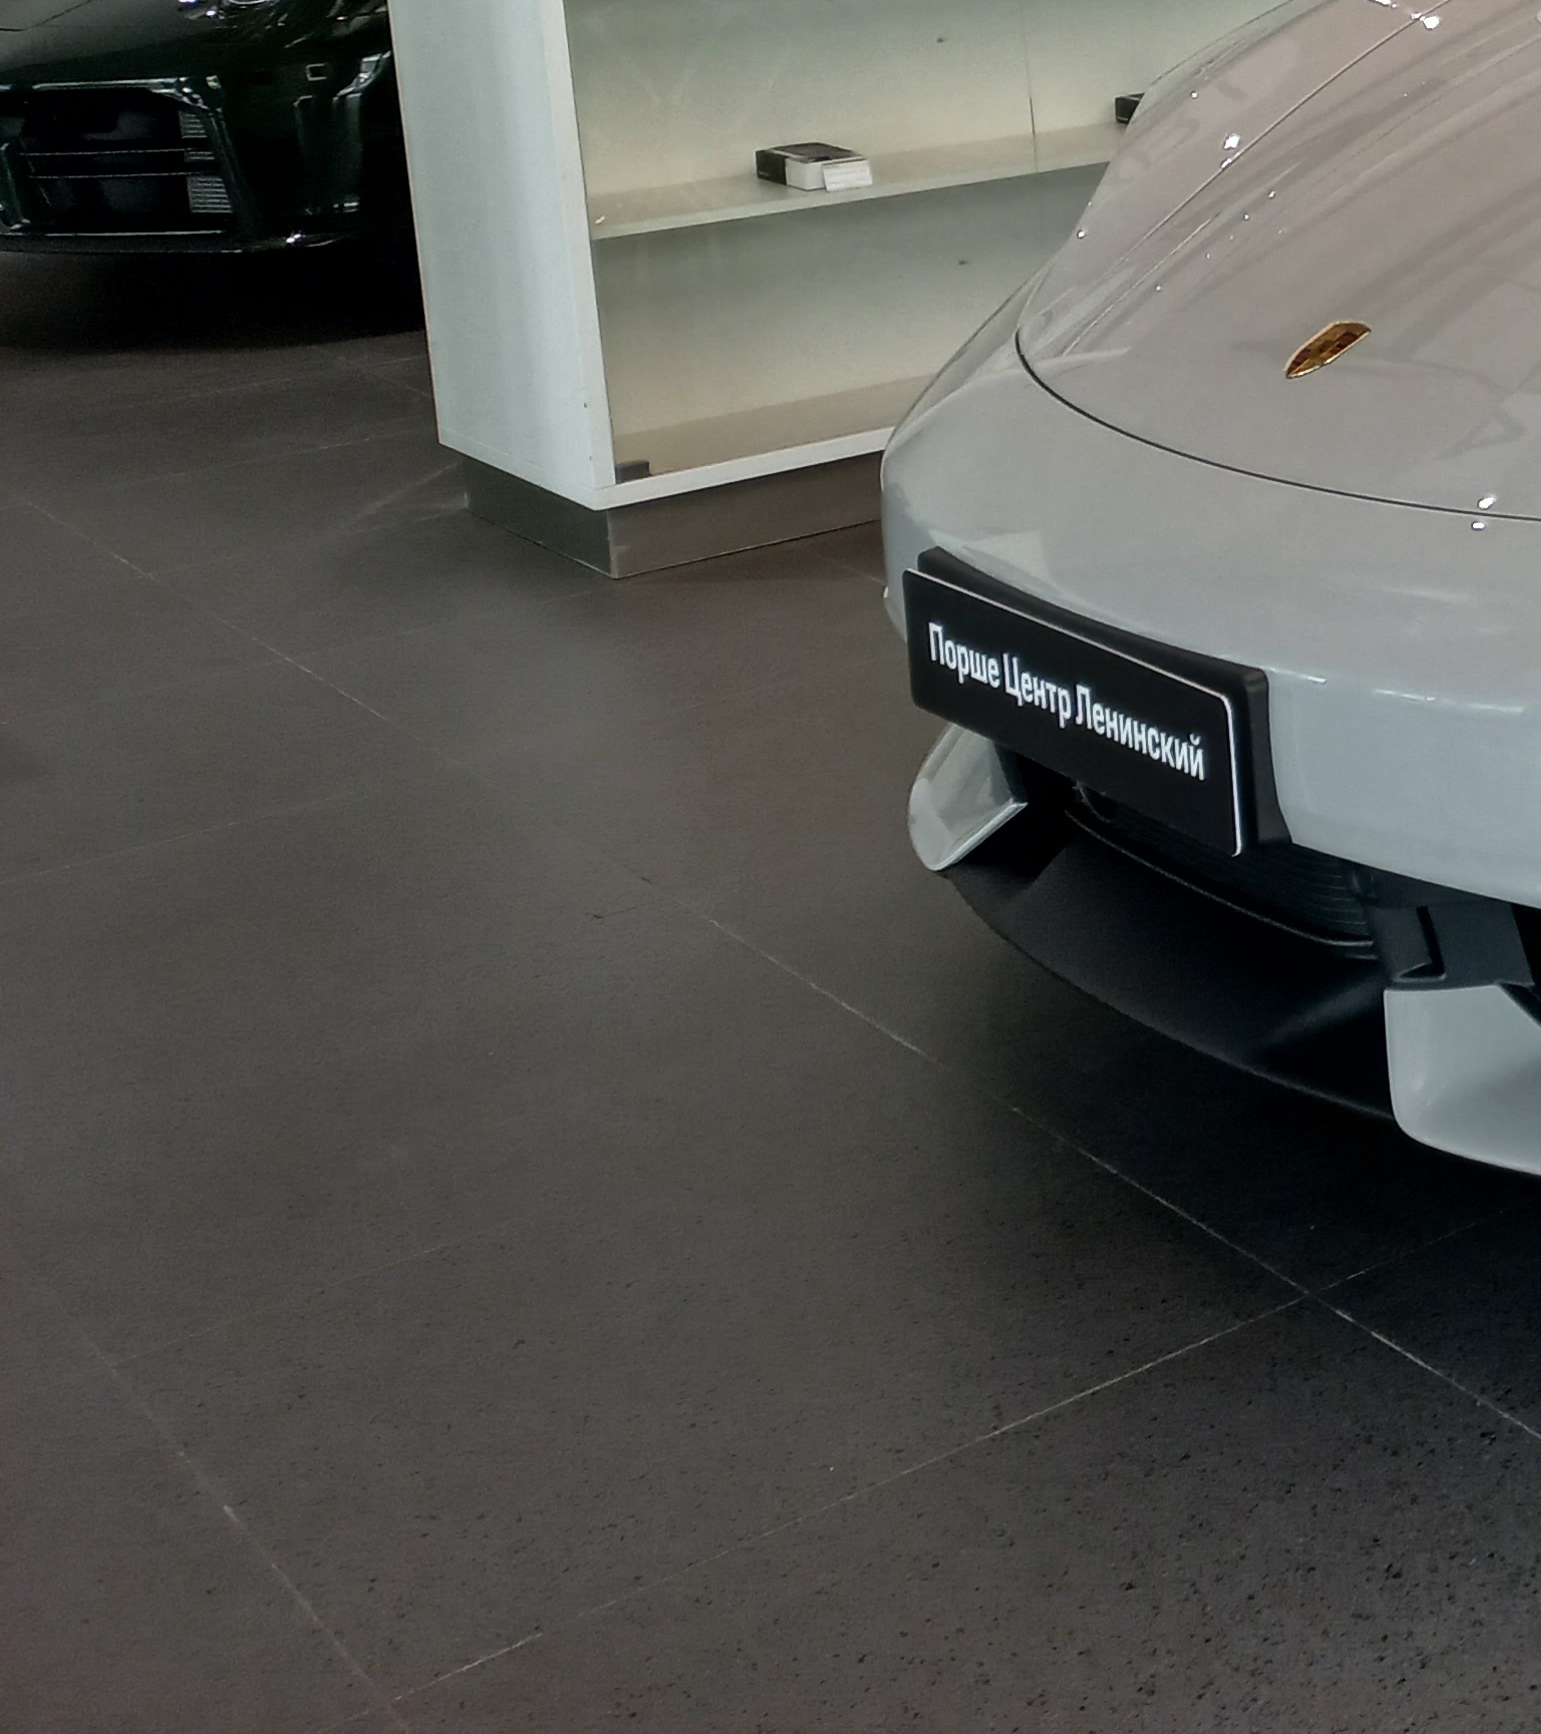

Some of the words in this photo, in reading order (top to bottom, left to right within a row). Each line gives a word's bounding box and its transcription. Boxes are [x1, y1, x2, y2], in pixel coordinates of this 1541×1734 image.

[928, 622, 1001, 690] Порше
[1002, 652, 1072, 728] Центр
[1075, 683, 1206, 781] Ленинский
